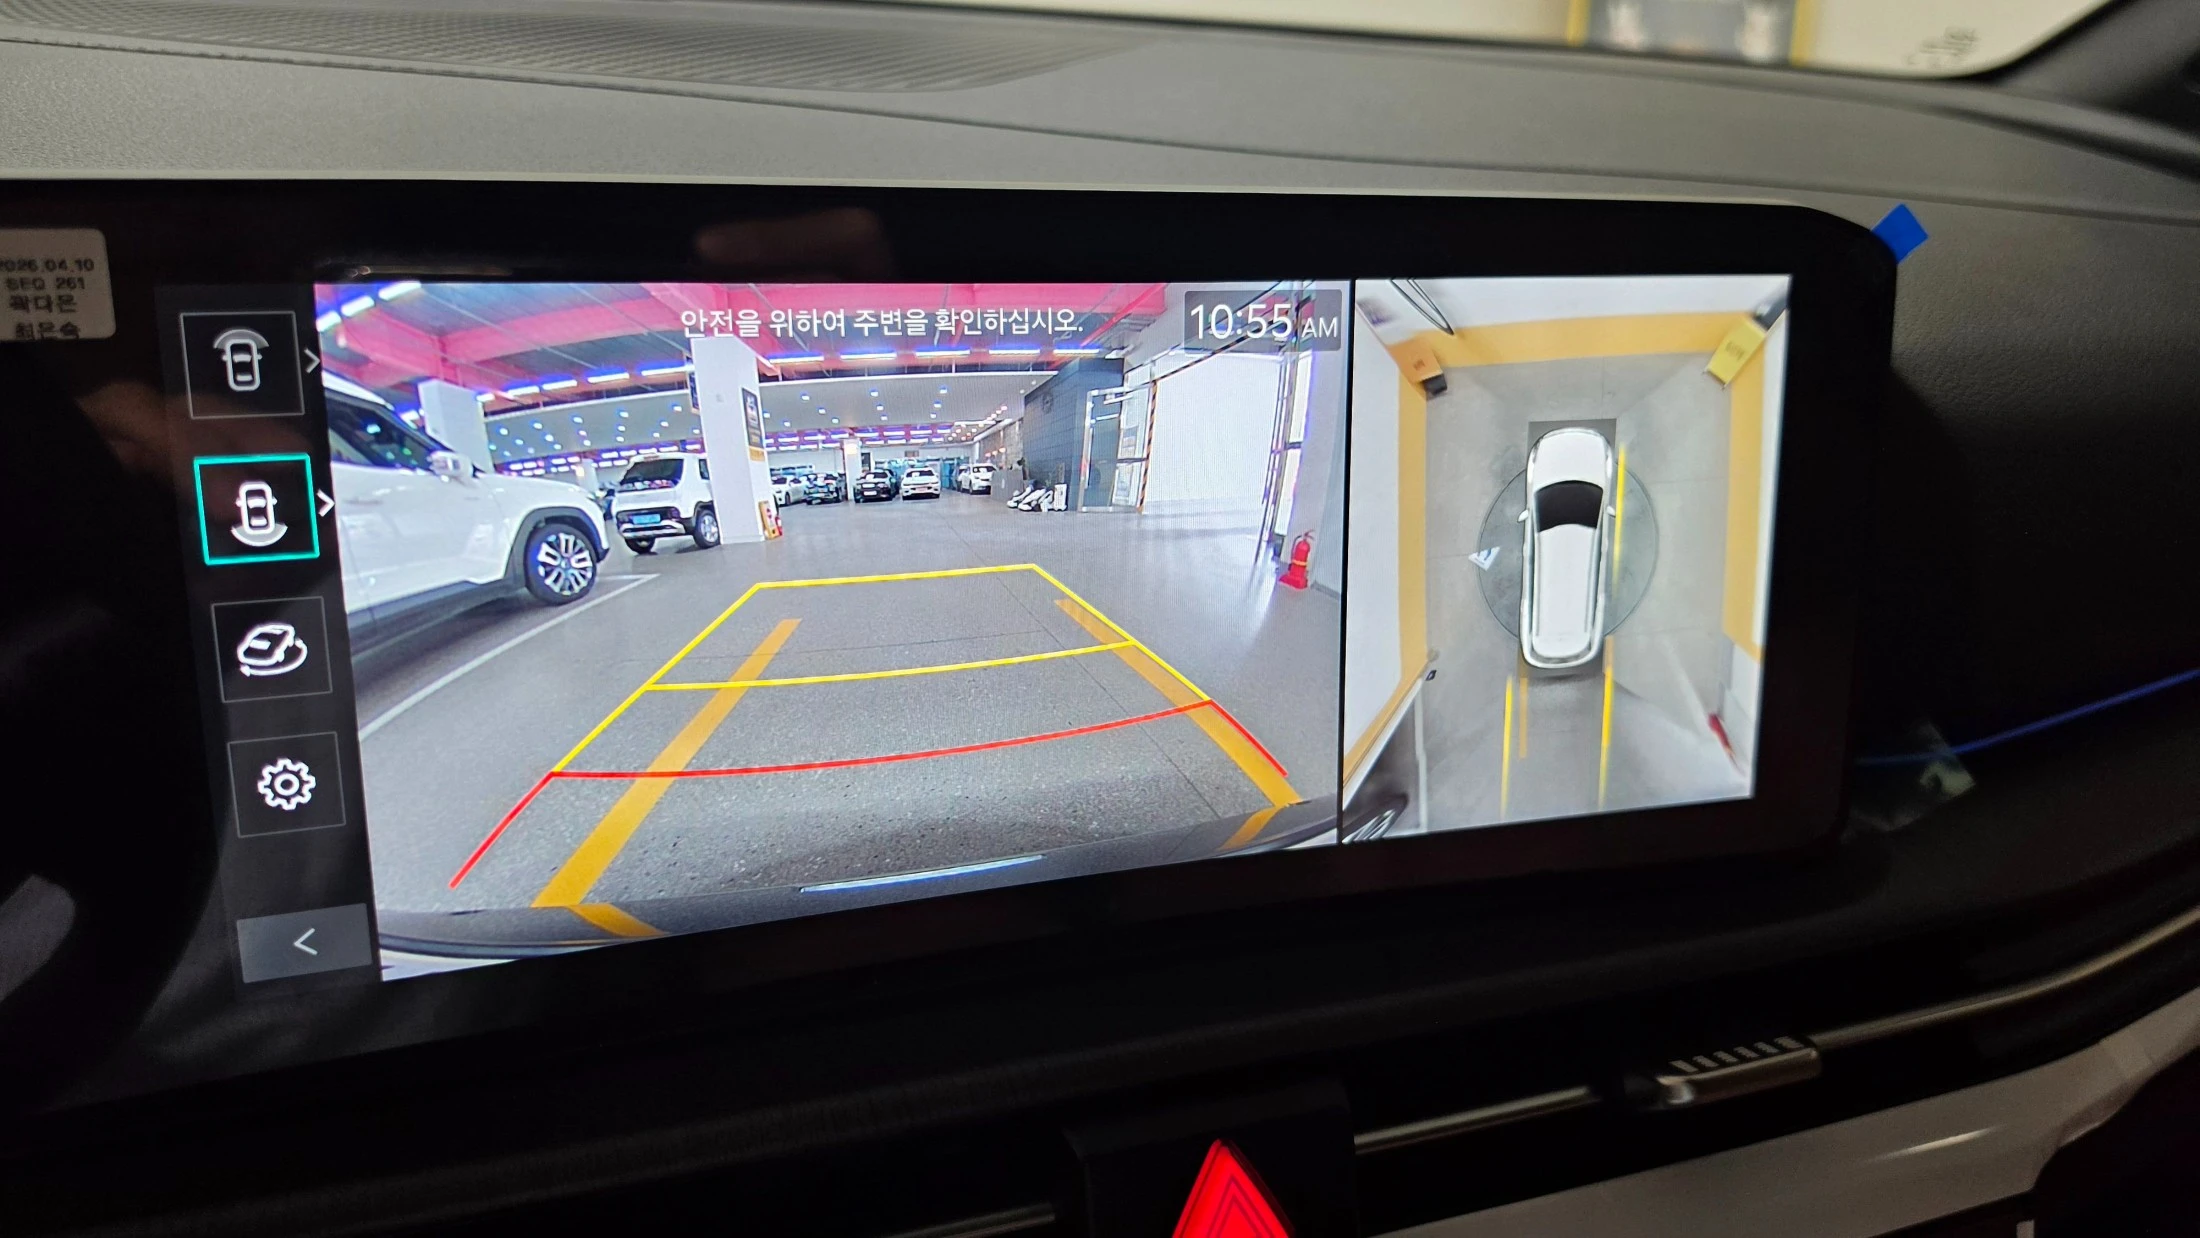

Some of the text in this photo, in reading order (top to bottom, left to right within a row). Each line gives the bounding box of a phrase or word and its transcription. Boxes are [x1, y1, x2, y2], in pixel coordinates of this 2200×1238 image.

[6, 277, 85, 291] SEQ 261
[681, 307, 1084, 338] 안전을 위하여 주변을 확인하십시오.
[1190, 303, 1339, 340] 10:55 AM
